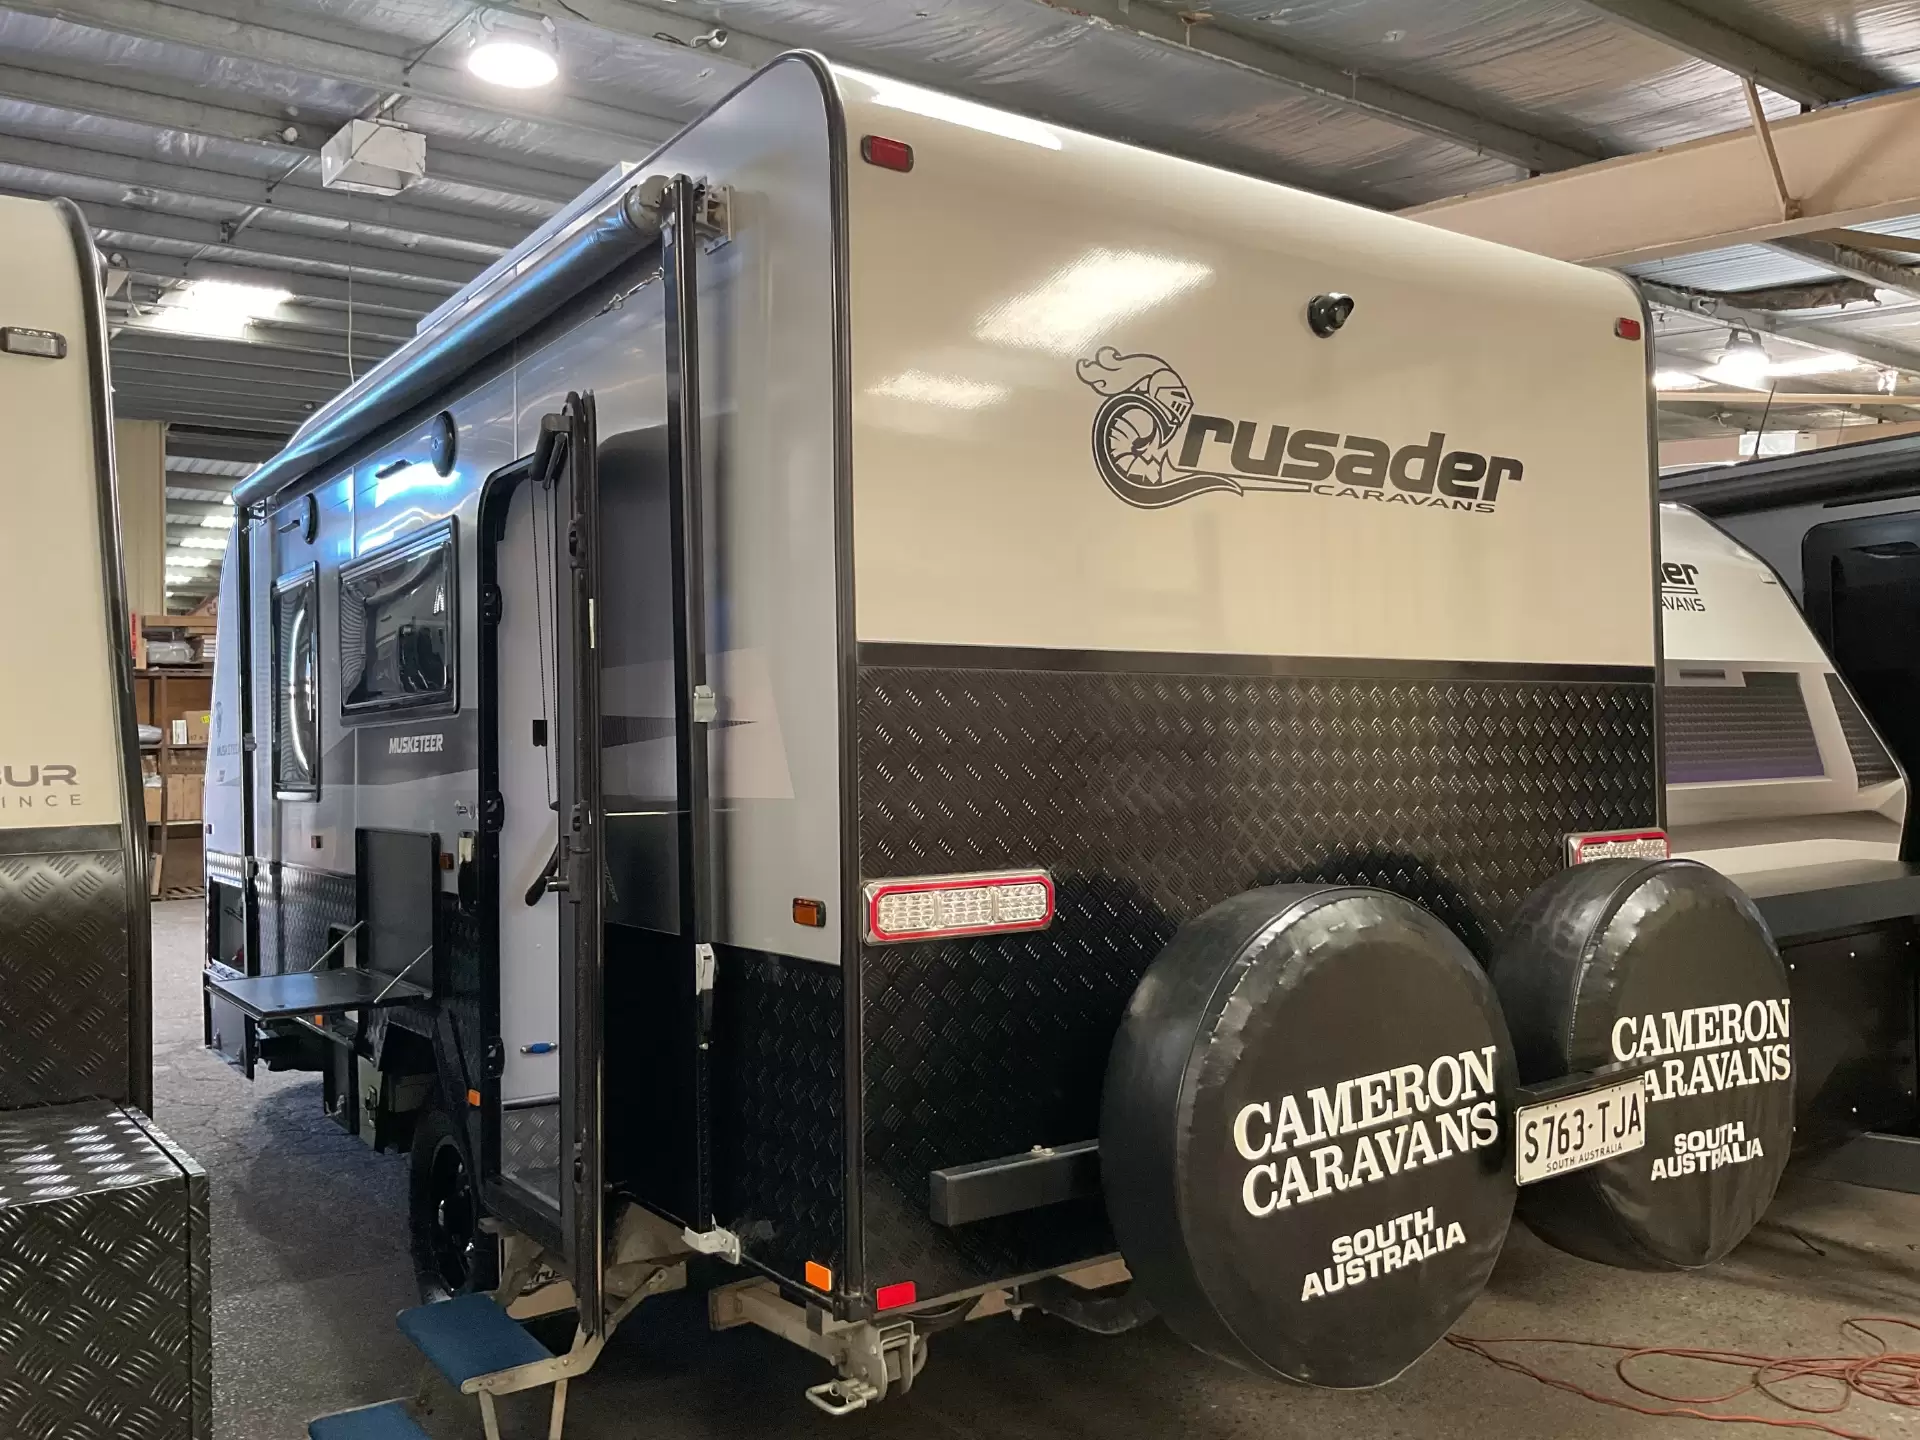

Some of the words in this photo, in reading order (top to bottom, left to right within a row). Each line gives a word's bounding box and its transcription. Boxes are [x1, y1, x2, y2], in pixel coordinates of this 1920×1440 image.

[1313, 484, 1495, 513] CARAVANS
[1661, 562, 1699, 585] er
[389, 734, 443, 754] MUSKETEER
[0, 765, 80, 787] UR
[1611, 998, 1790, 1062] CAMERON
[1645, 1044, 1791, 1102] ARAVANS
[1233, 1045, 1497, 1160] CAMERON
[1242, 1100, 1499, 1217] CARAVANS
[1546, 1156, 1576, 1173] SOUTH
[1578, 1142, 1623, 1163] AUSTRALIA
[1651, 1137, 1764, 1181] AUSTRALIA
[1674, 1121, 1745, 1155] SOUTH
[1332, 1206, 1435, 1265] SOUTH
[1301, 1221, 1466, 1301] AUSTRALIA
